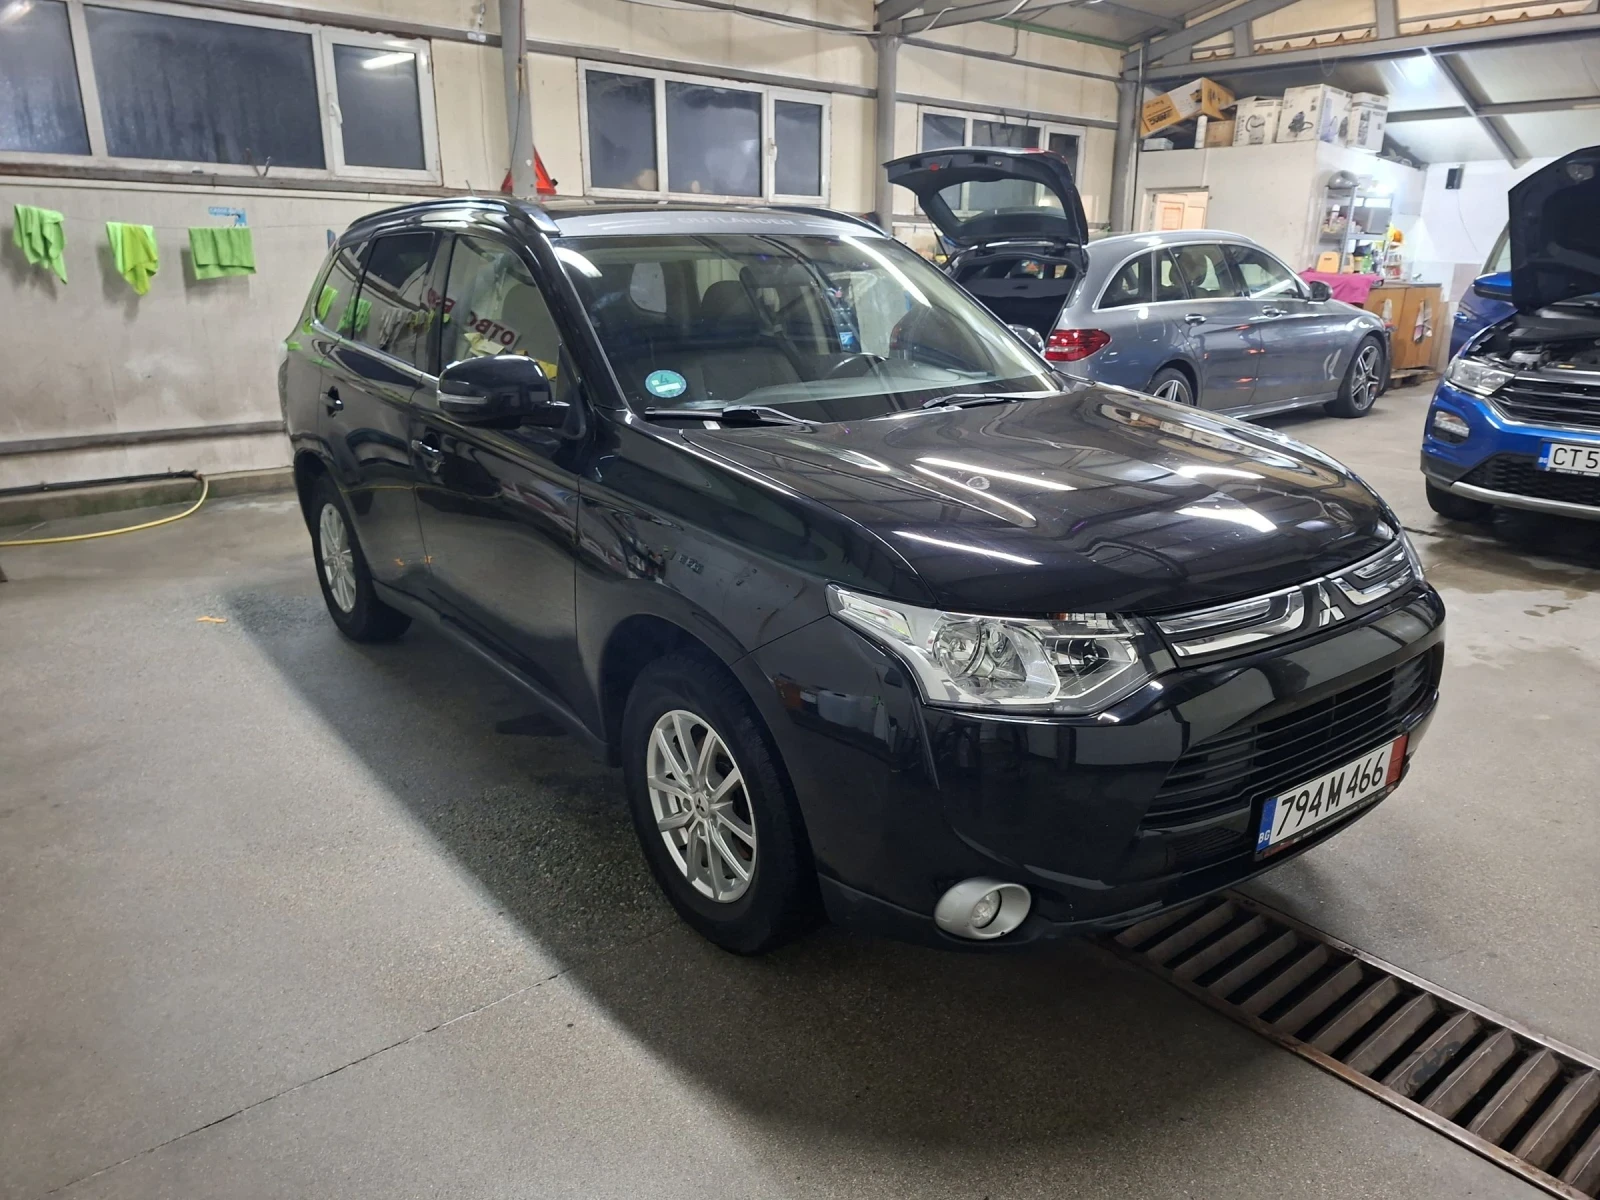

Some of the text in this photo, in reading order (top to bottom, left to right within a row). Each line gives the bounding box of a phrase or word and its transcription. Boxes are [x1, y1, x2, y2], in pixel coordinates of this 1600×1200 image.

[676, 217, 797, 226] OUTLANDER
[1553, 447, 1583, 467] CT
[1258, 829, 1271, 844] BG
